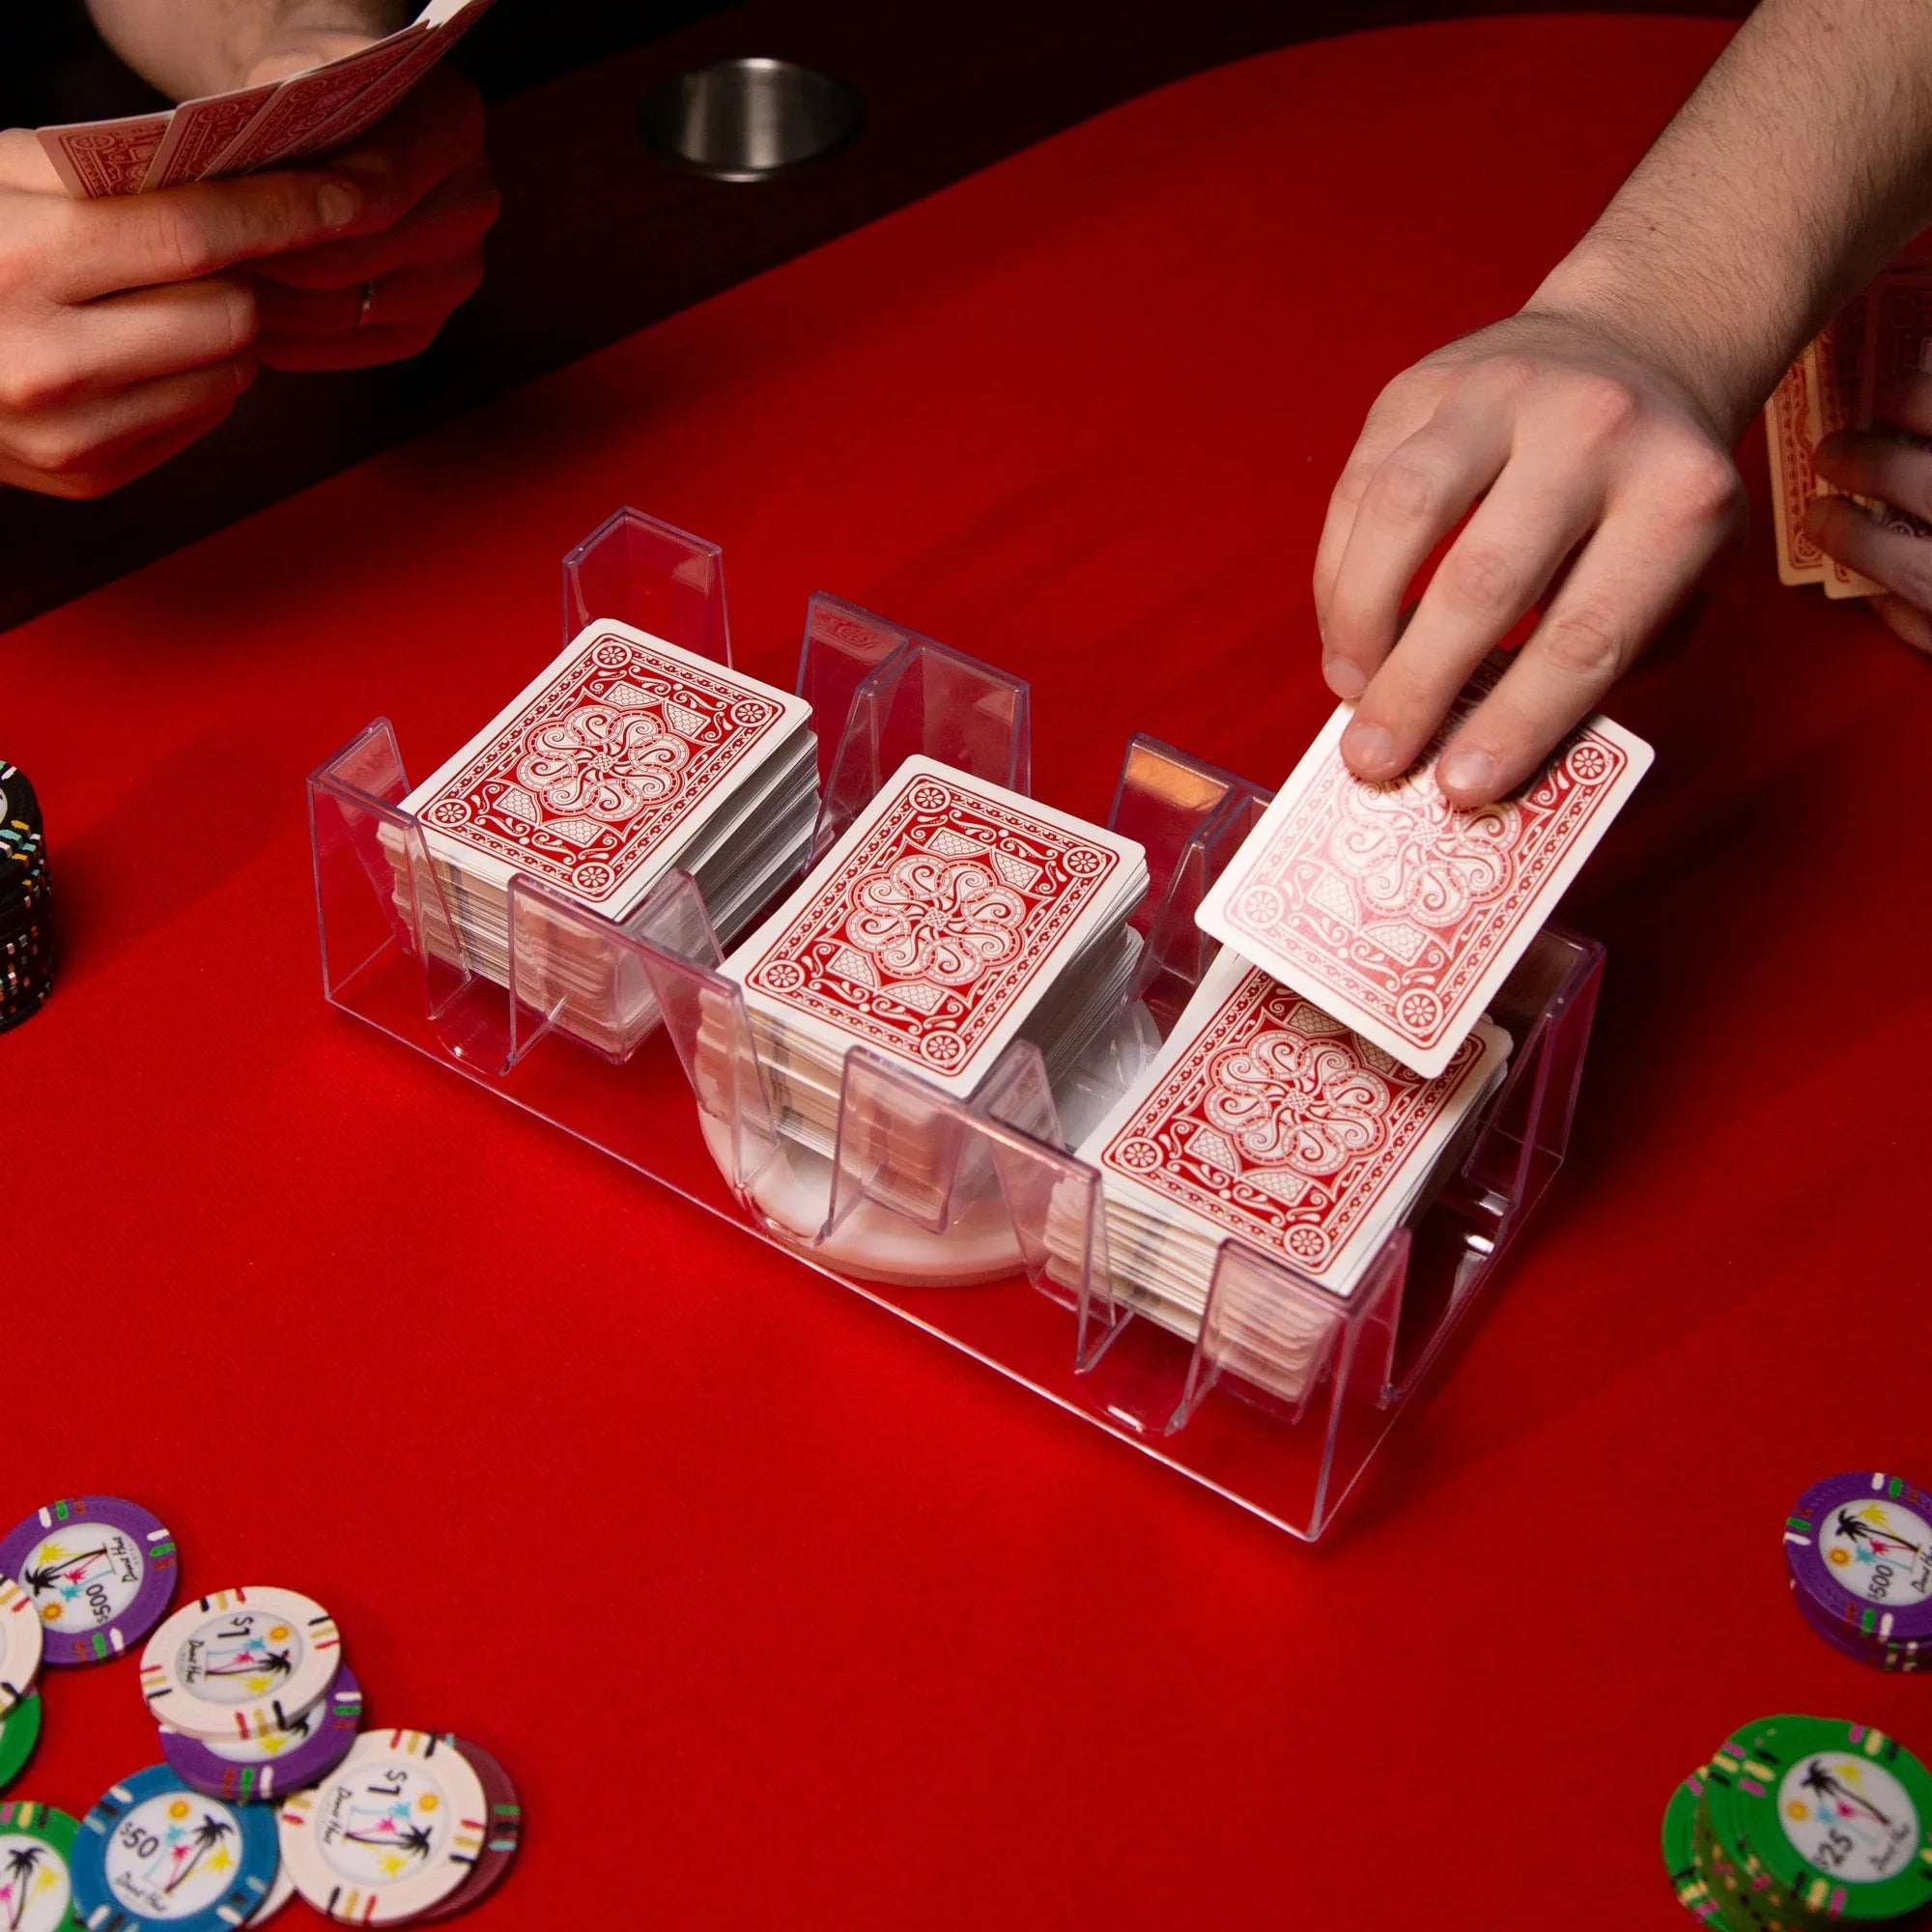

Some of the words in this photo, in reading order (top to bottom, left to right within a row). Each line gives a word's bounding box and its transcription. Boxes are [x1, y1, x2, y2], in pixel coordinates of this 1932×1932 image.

[1867, 1564, 1893, 1600] $500
[85, 1583, 111, 1623] $500
[217, 1616, 254, 1638] $1
[367, 1770, 408, 1795] $1
[119, 1821, 158, 1858] $50
